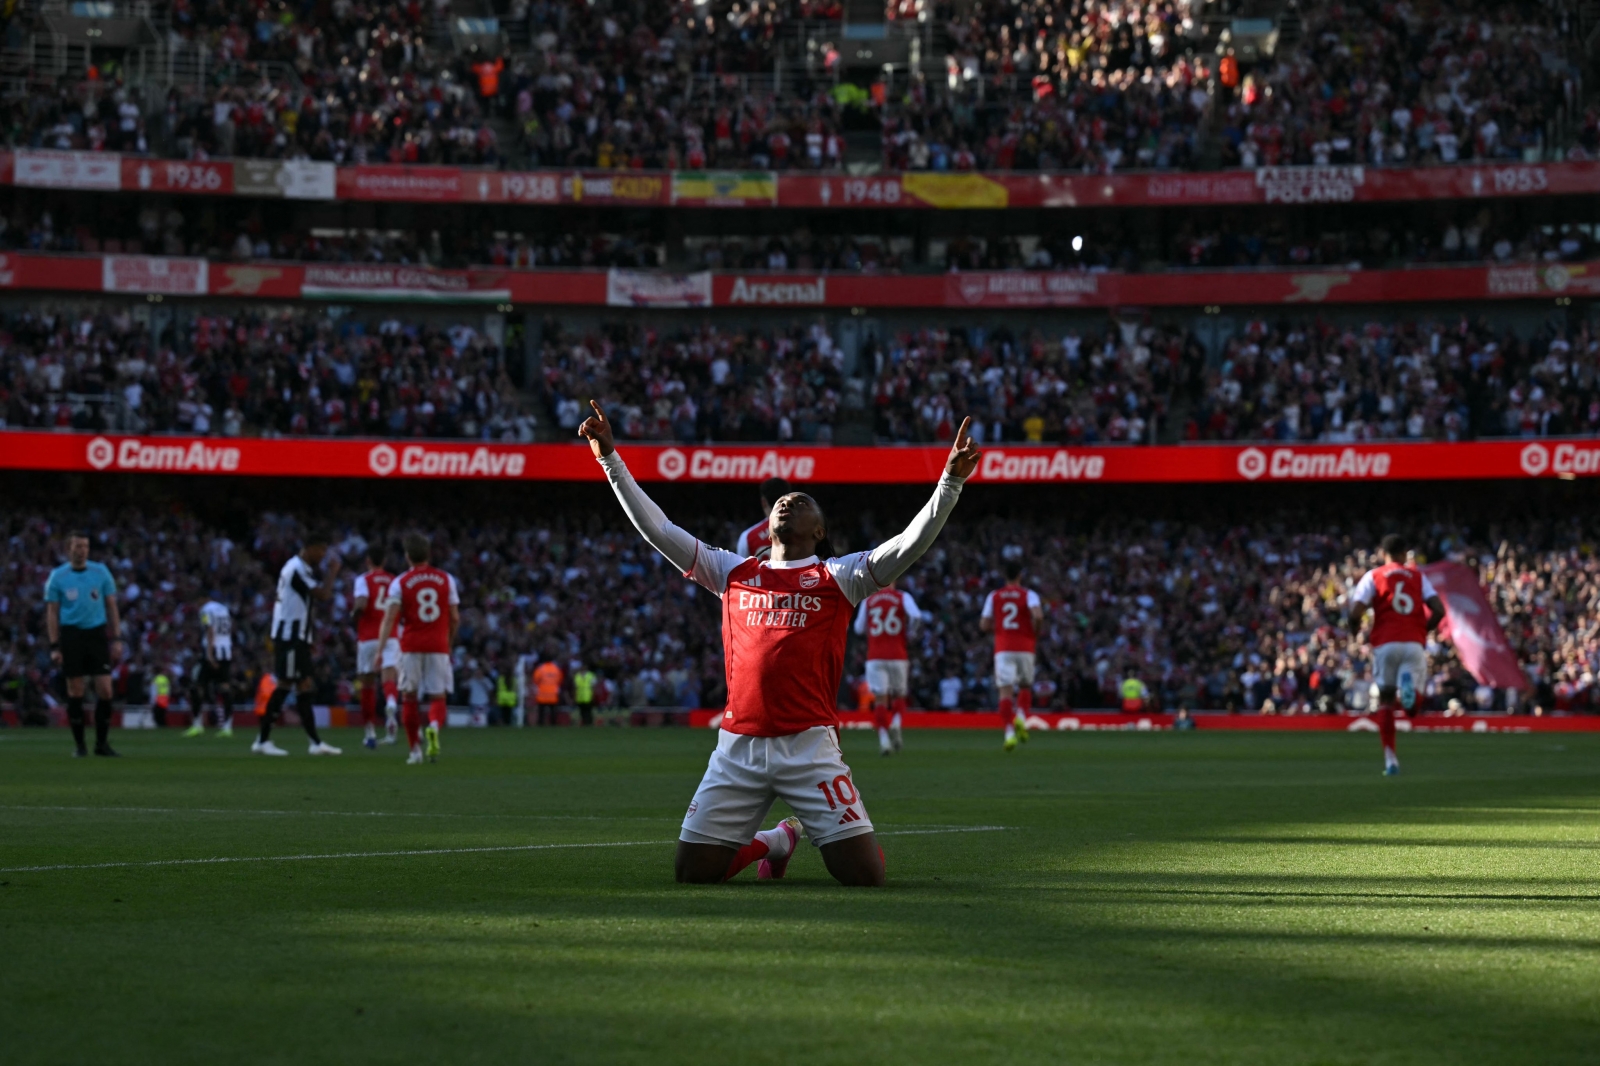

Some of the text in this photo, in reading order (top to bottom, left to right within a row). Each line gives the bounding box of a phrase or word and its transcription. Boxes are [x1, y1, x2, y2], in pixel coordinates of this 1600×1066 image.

[165, 165, 222, 191] 1936
[500, 175, 557, 200] 1938
[842, 179, 901, 203] 1948
[1493, 167, 1548, 192] 1953
[1264, 183, 1355, 203] POLAND
[730, 277, 826, 304] Arsenal
[117, 440, 241, 470] ComAve
[400, 446, 526, 476] ComAve
[689, 450, 815, 478] ComAve
[981, 450, 1105, 479] ComAve
[1270, 448, 1391, 477] ComAve
[416, 587, 441, 623] 8
[739, 592, 821, 611] Emirates
[1392, 581, 1415, 615] 6
[746, 611, 807, 626] FLY BETTER
[869, 605, 903, 637] 36
[1001, 601, 1020, 630] 2
[817, 775, 857, 811] 10
